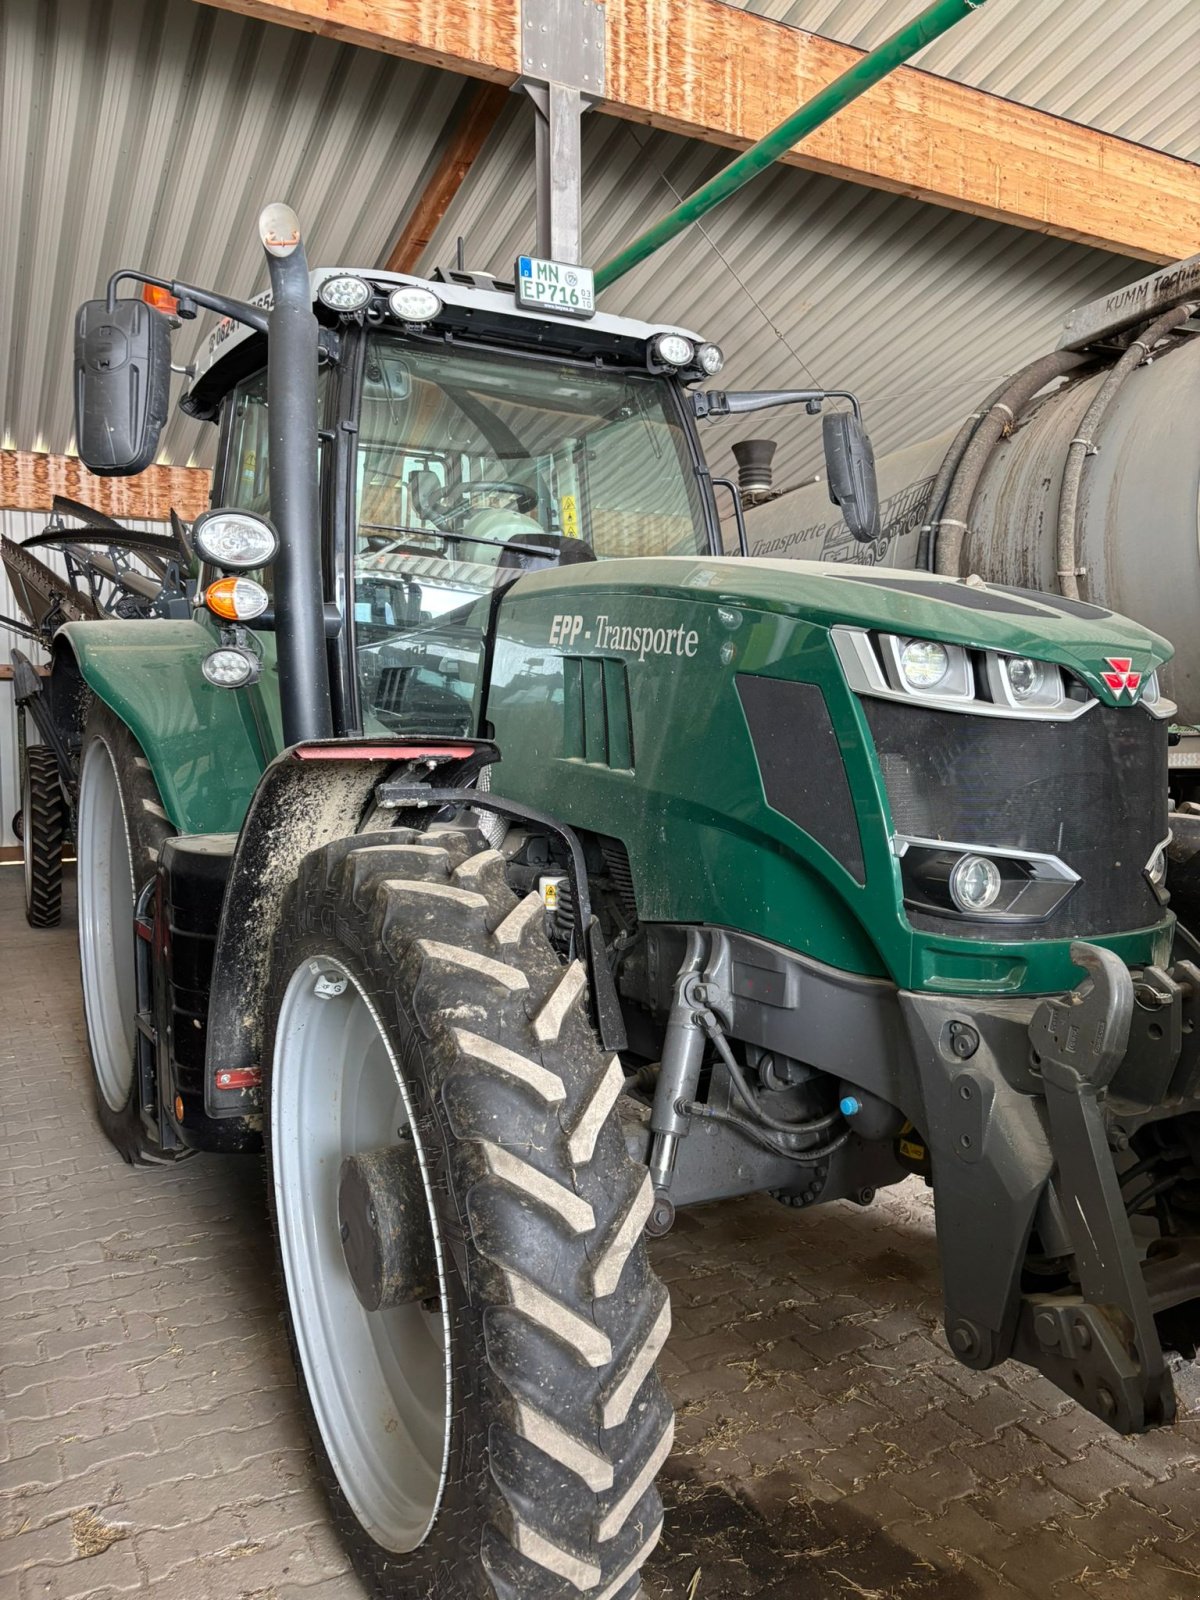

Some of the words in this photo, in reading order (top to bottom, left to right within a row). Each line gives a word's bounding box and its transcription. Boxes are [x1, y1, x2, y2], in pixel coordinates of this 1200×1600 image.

[537, 262, 559, 283] MN
[1105, 281, 1149, 312] KUMM
[751, 522, 826, 557] Transporte
[549, 614, 584, 646] EPP
[595, 615, 699, 662] Transporte
